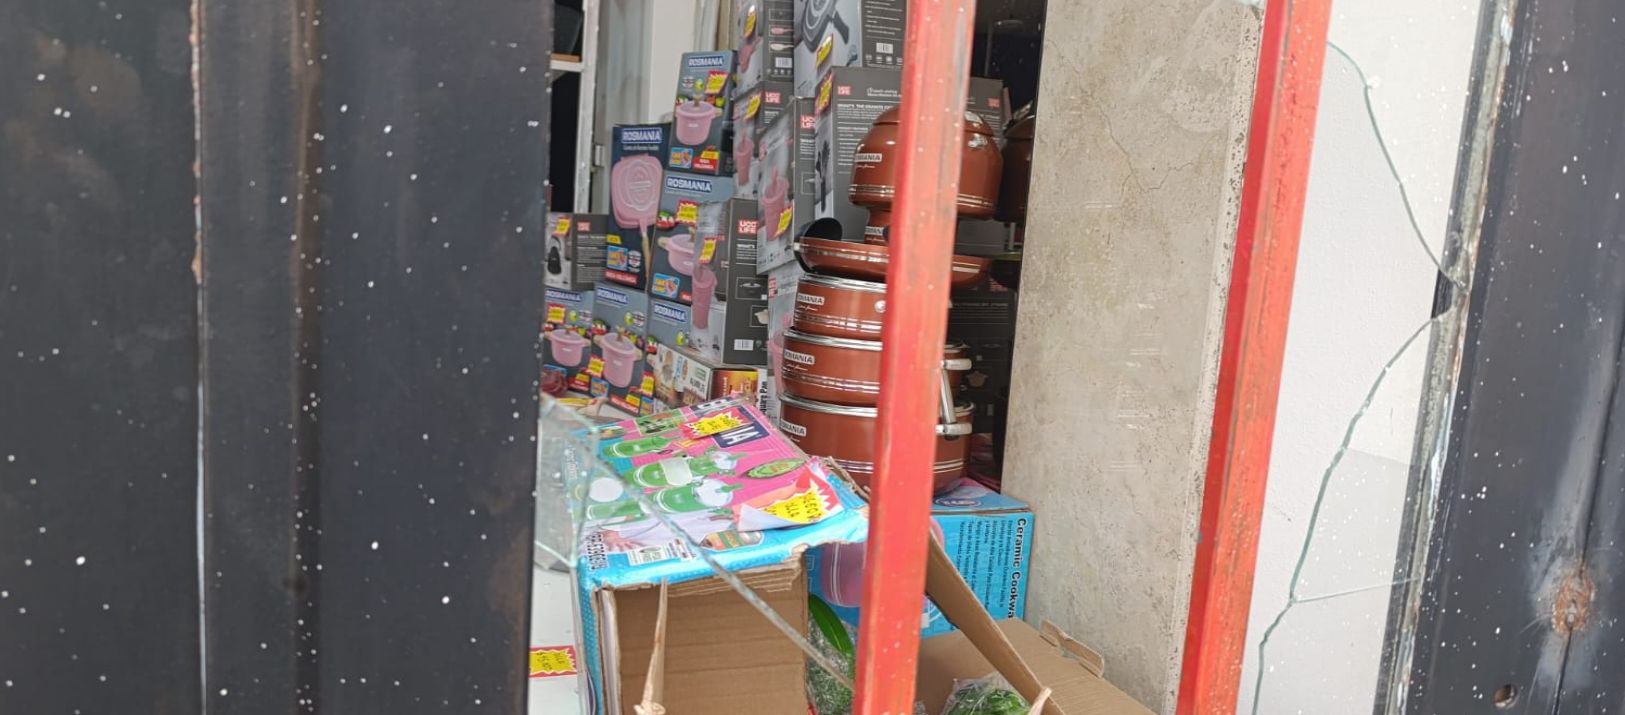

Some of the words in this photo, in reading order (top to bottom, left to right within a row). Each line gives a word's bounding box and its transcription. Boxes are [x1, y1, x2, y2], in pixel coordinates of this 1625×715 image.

[623, 130, 661, 141] ROSMANIA
[667, 177, 712, 192] ROSMANIA
[760, 381, 768, 393] Pan
[1013, 518, 1026, 568] Ceramic
[1008, 572, 1020, 618] Cookwa
